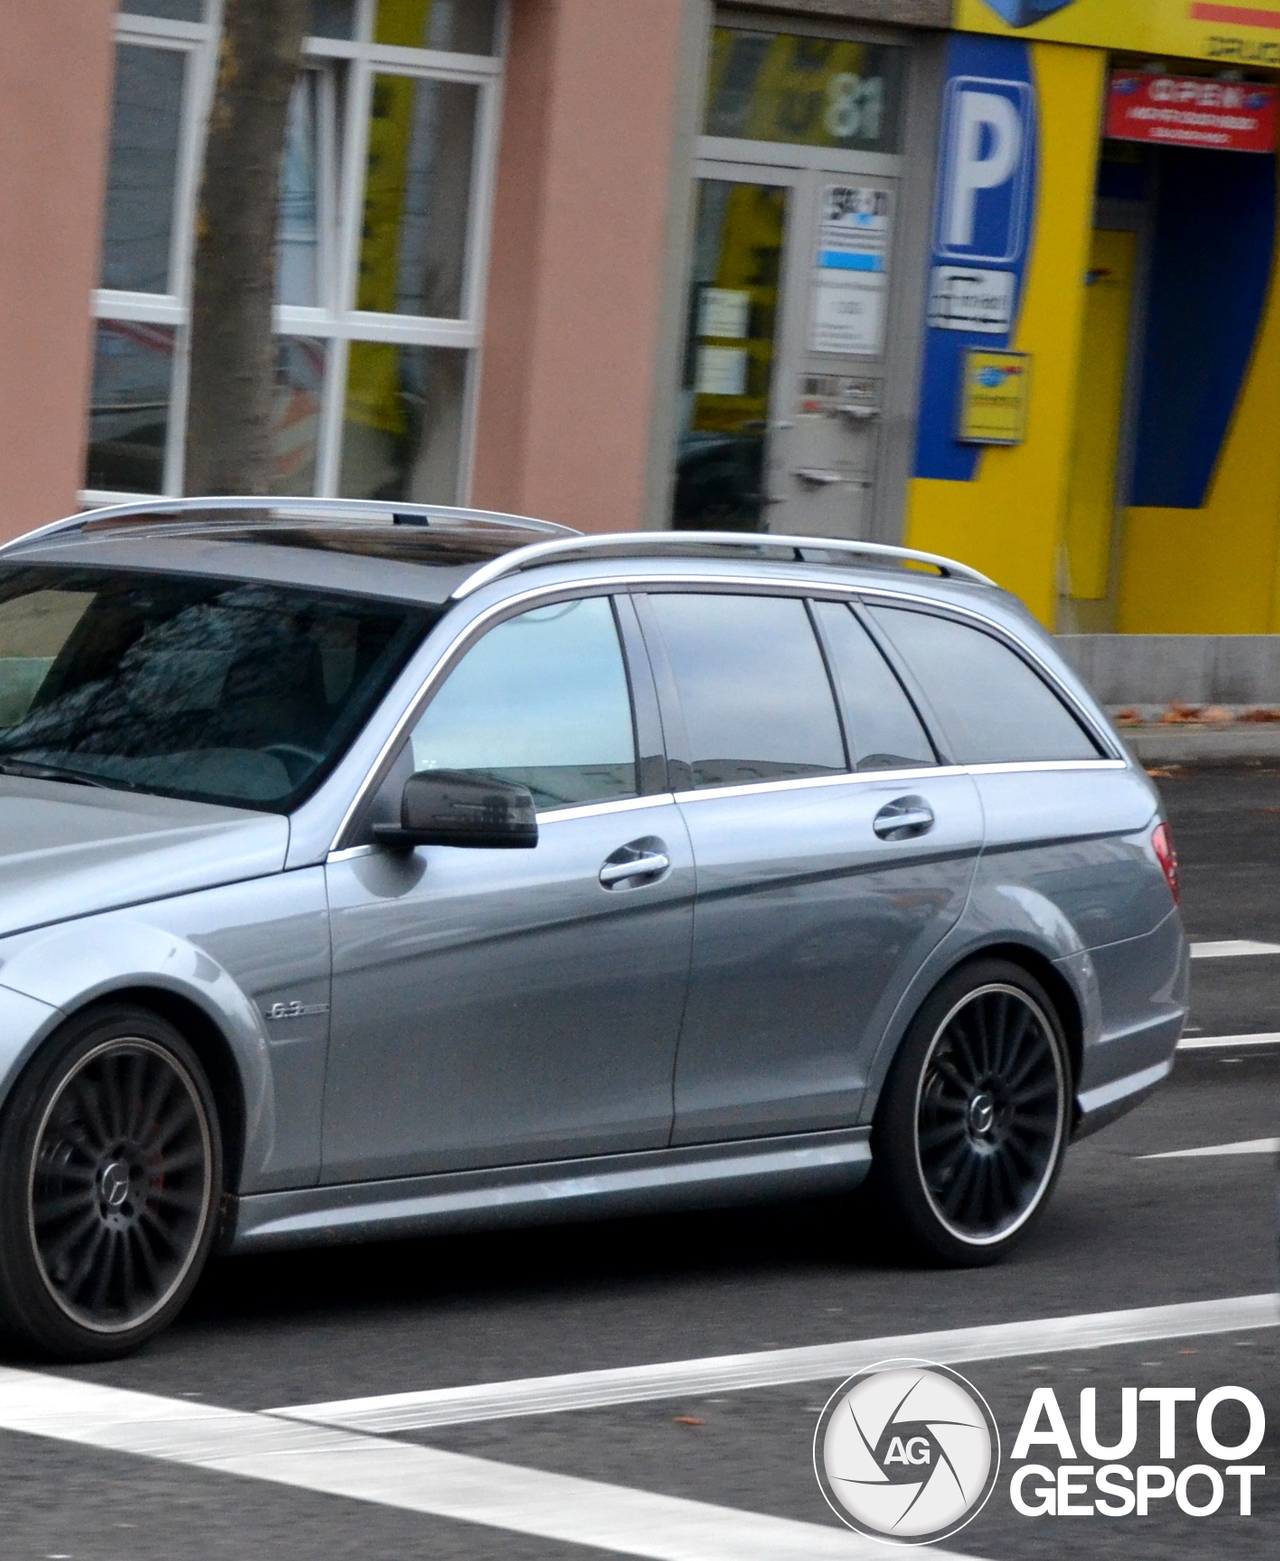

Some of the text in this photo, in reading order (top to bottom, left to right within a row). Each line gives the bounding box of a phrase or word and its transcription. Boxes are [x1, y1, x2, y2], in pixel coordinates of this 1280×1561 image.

[825, 72, 884, 139] 81
[1149, 79, 1244, 108] OPEN
[949, 90, 1021, 246] P
